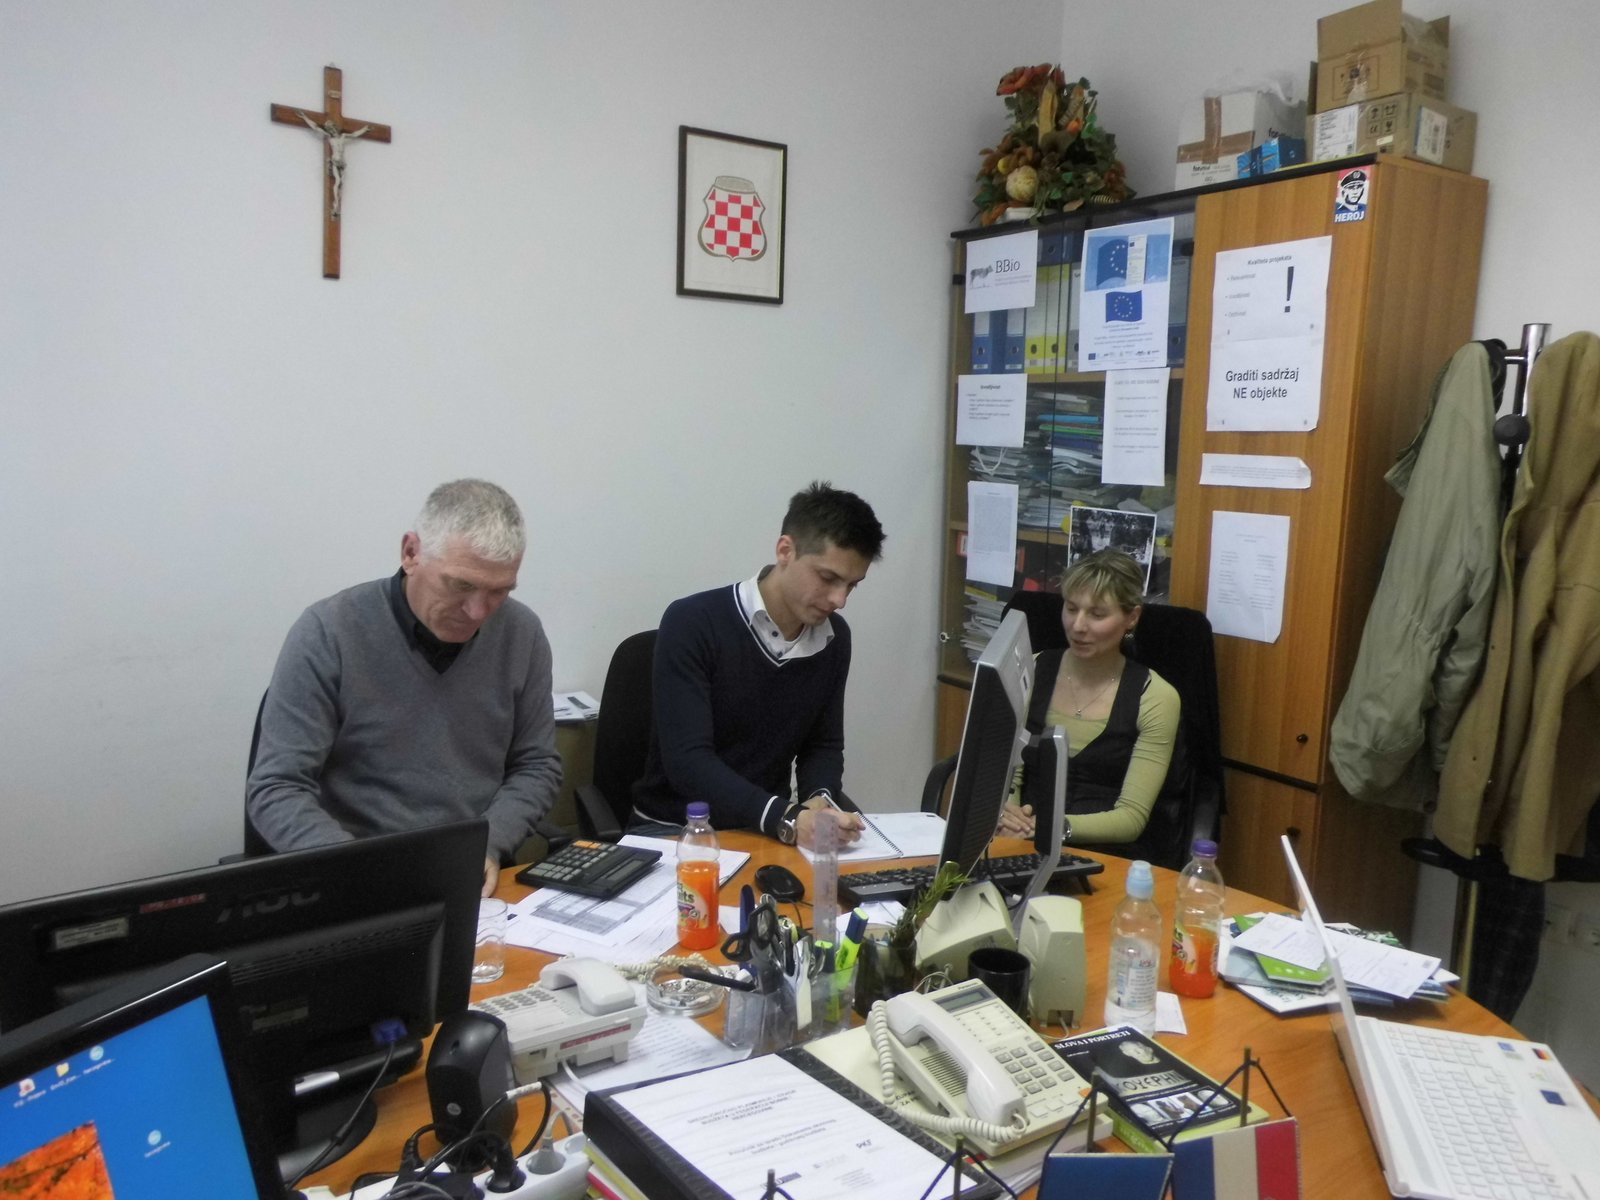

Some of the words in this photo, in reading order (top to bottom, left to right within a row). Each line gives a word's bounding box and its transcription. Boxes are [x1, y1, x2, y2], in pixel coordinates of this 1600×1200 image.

[1334, 210, 1365, 223] HEROJ
[994, 258, 1021, 274] BBio
[1225, 369, 1259, 382] Graditi
[1261, 367, 1300, 383] sadržaj
[1233, 387, 1248, 399] NE
[1250, 386, 1288, 401] objekte
[1054, 1040, 1084, 1050] SLOVA
[1088, 1030, 1131, 1043] PORTRETI
